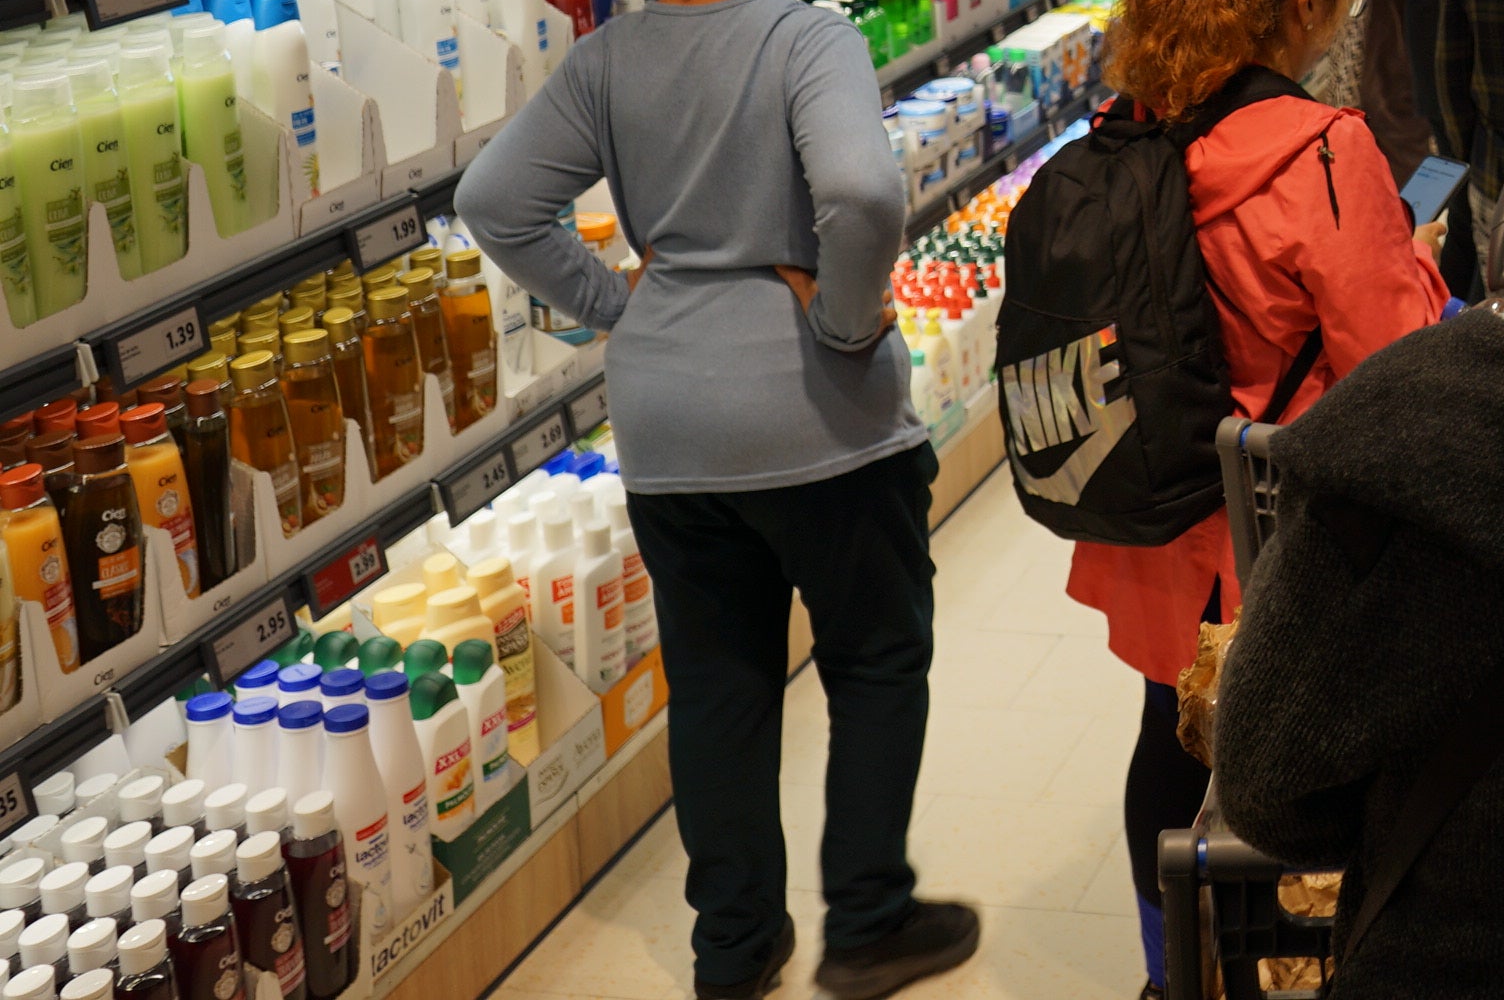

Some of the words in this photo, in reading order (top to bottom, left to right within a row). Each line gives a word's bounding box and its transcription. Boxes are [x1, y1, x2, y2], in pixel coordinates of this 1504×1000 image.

[96, 139, 119, 153] Cien
[50, 158, 74, 172] Cien
[393, 218, 416, 242] 1.99
[166, 322, 194, 350] 1.39
[1002, 323, 1120, 457] NIKE
[541, 424, 562, 449] 2.69
[159, 474, 178, 487] Cien
[483, 464, 506, 489] 2.45
[102, 508, 127, 521] Cien
[354, 552, 376, 577] 2.99
[213, 596, 231, 612] Cien
[256, 611, 286, 642] 2.95
[94, 669, 114, 686] Cien
[371, 892, 445, 977] lactovit
